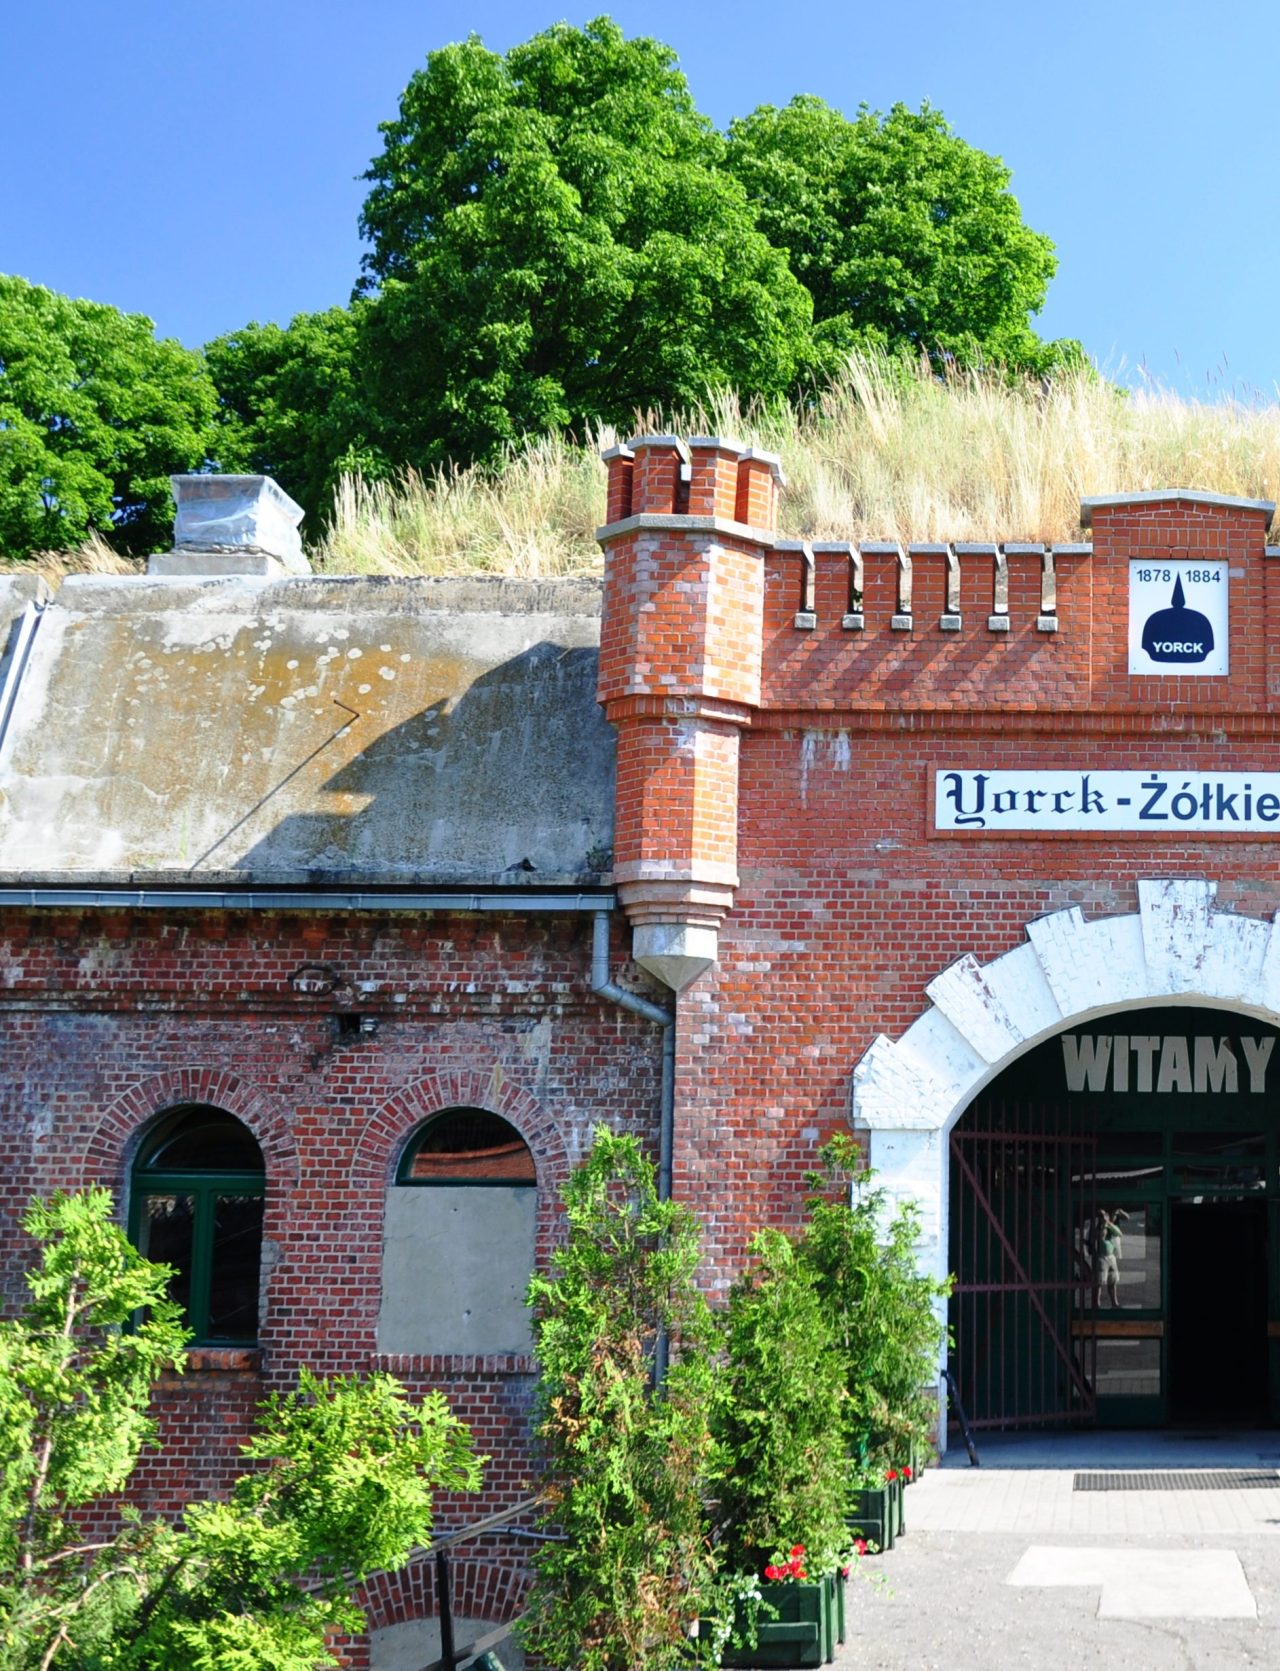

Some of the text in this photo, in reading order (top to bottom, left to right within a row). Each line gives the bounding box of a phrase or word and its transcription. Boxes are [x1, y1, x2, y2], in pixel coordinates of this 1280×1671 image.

[1136, 569, 1221, 583] 1878 1884
[1152, 641, 1204, 654] YORCK
[1061, 1034, 1276, 1094] WITAMY
